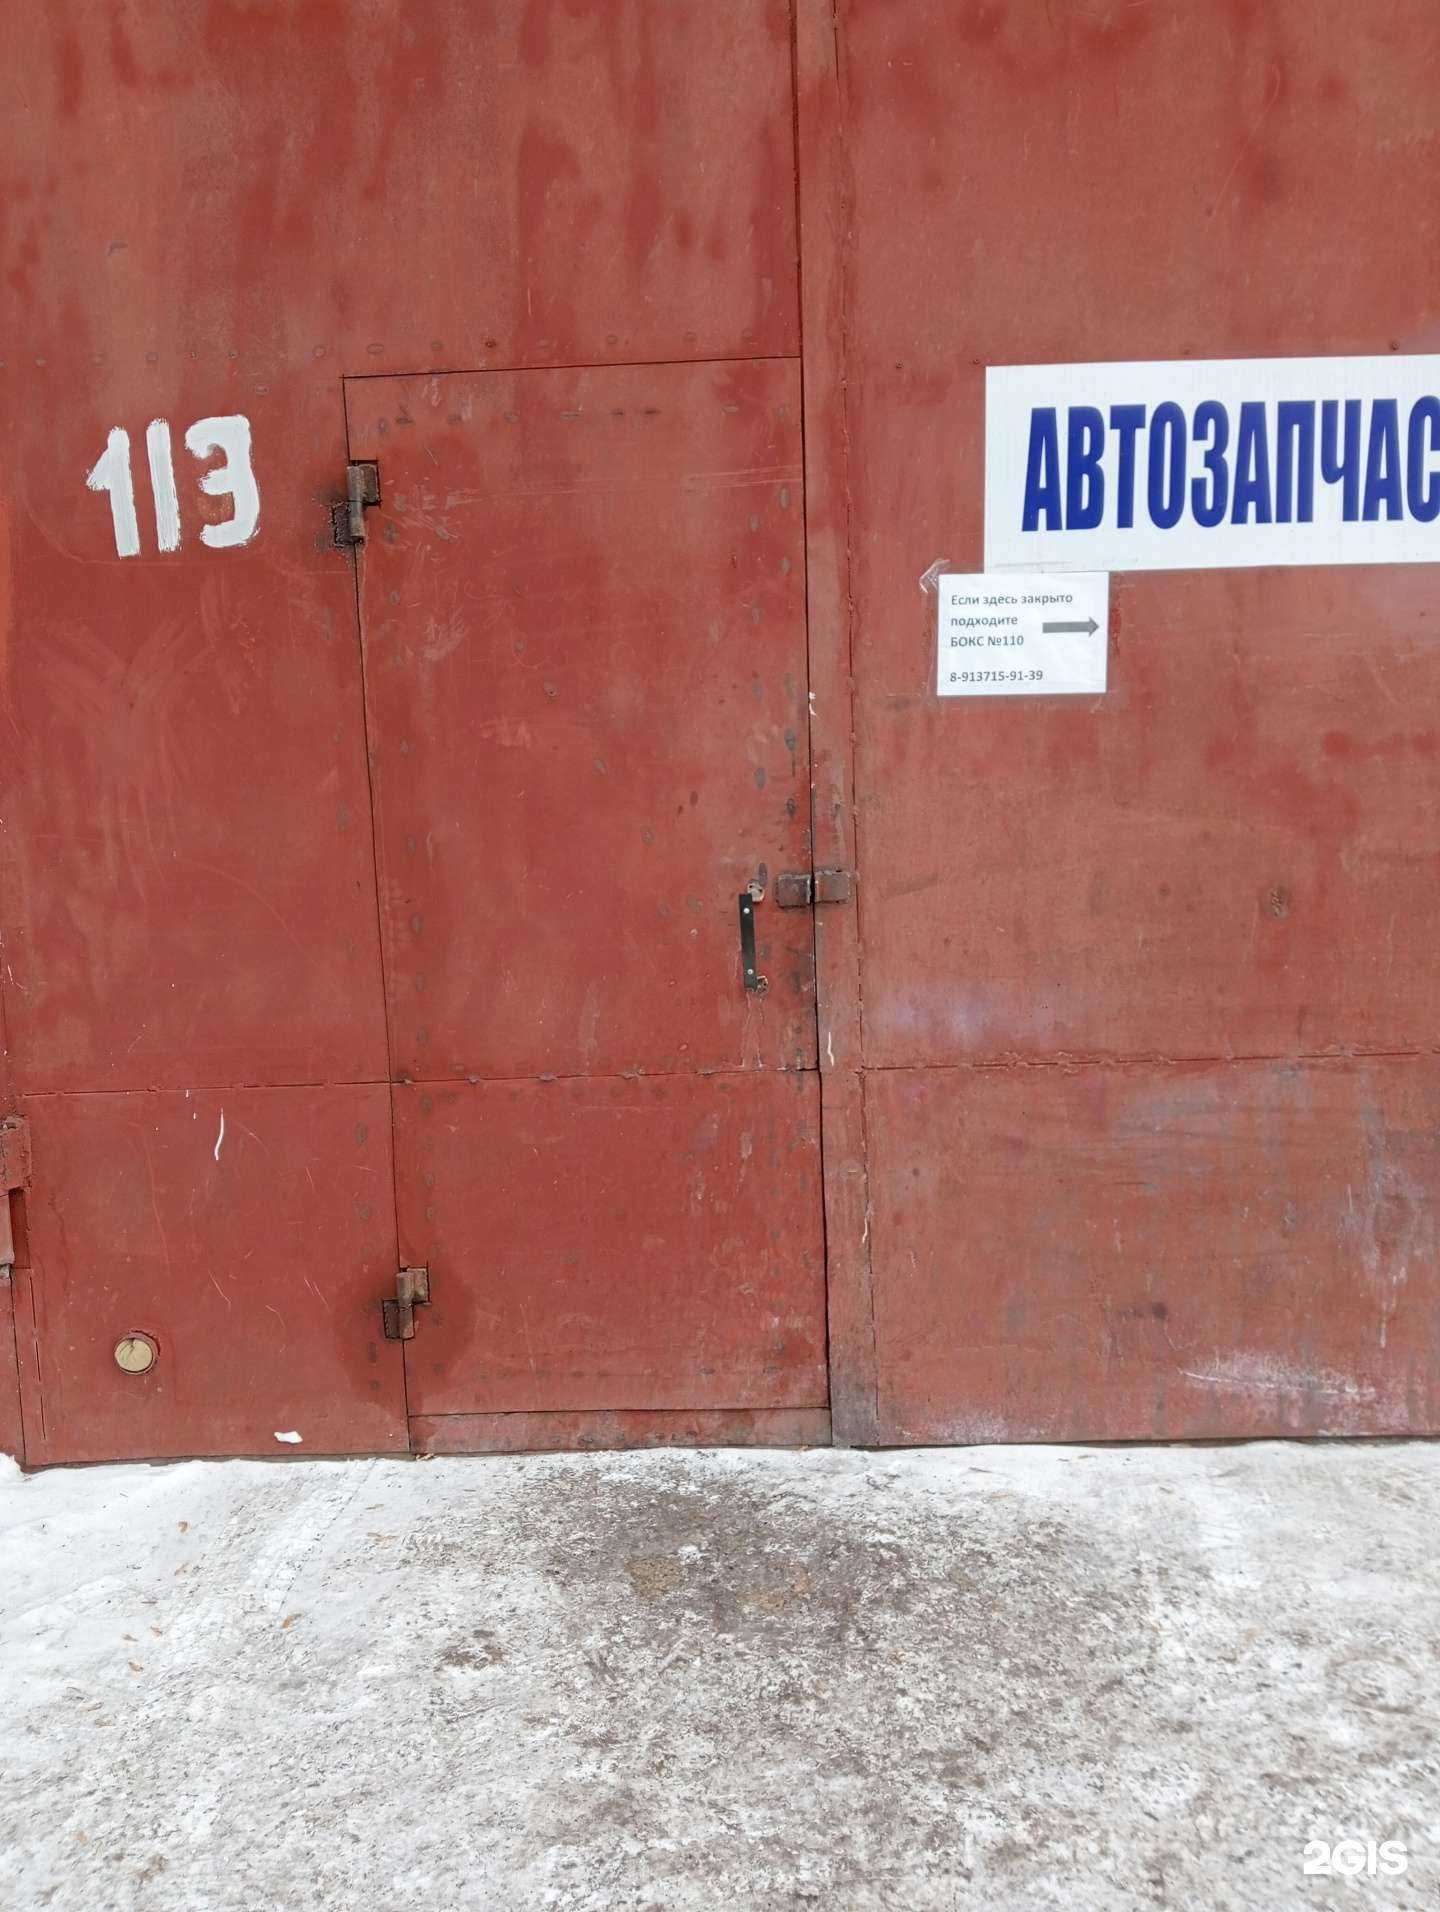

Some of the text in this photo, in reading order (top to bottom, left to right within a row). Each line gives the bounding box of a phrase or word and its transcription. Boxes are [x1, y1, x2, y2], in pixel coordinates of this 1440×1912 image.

[1021, 395, 1440, 532] АВТОЗАПЧАС
[85, 414, 261, 559] 113
[951, 593, 1073, 606] Если здесь закрыто
[951, 615, 1018, 628] подходите
[951, 635, 1025, 648] БОКС №110
[950, 670, 1044, 683] 8-913715-91-39
